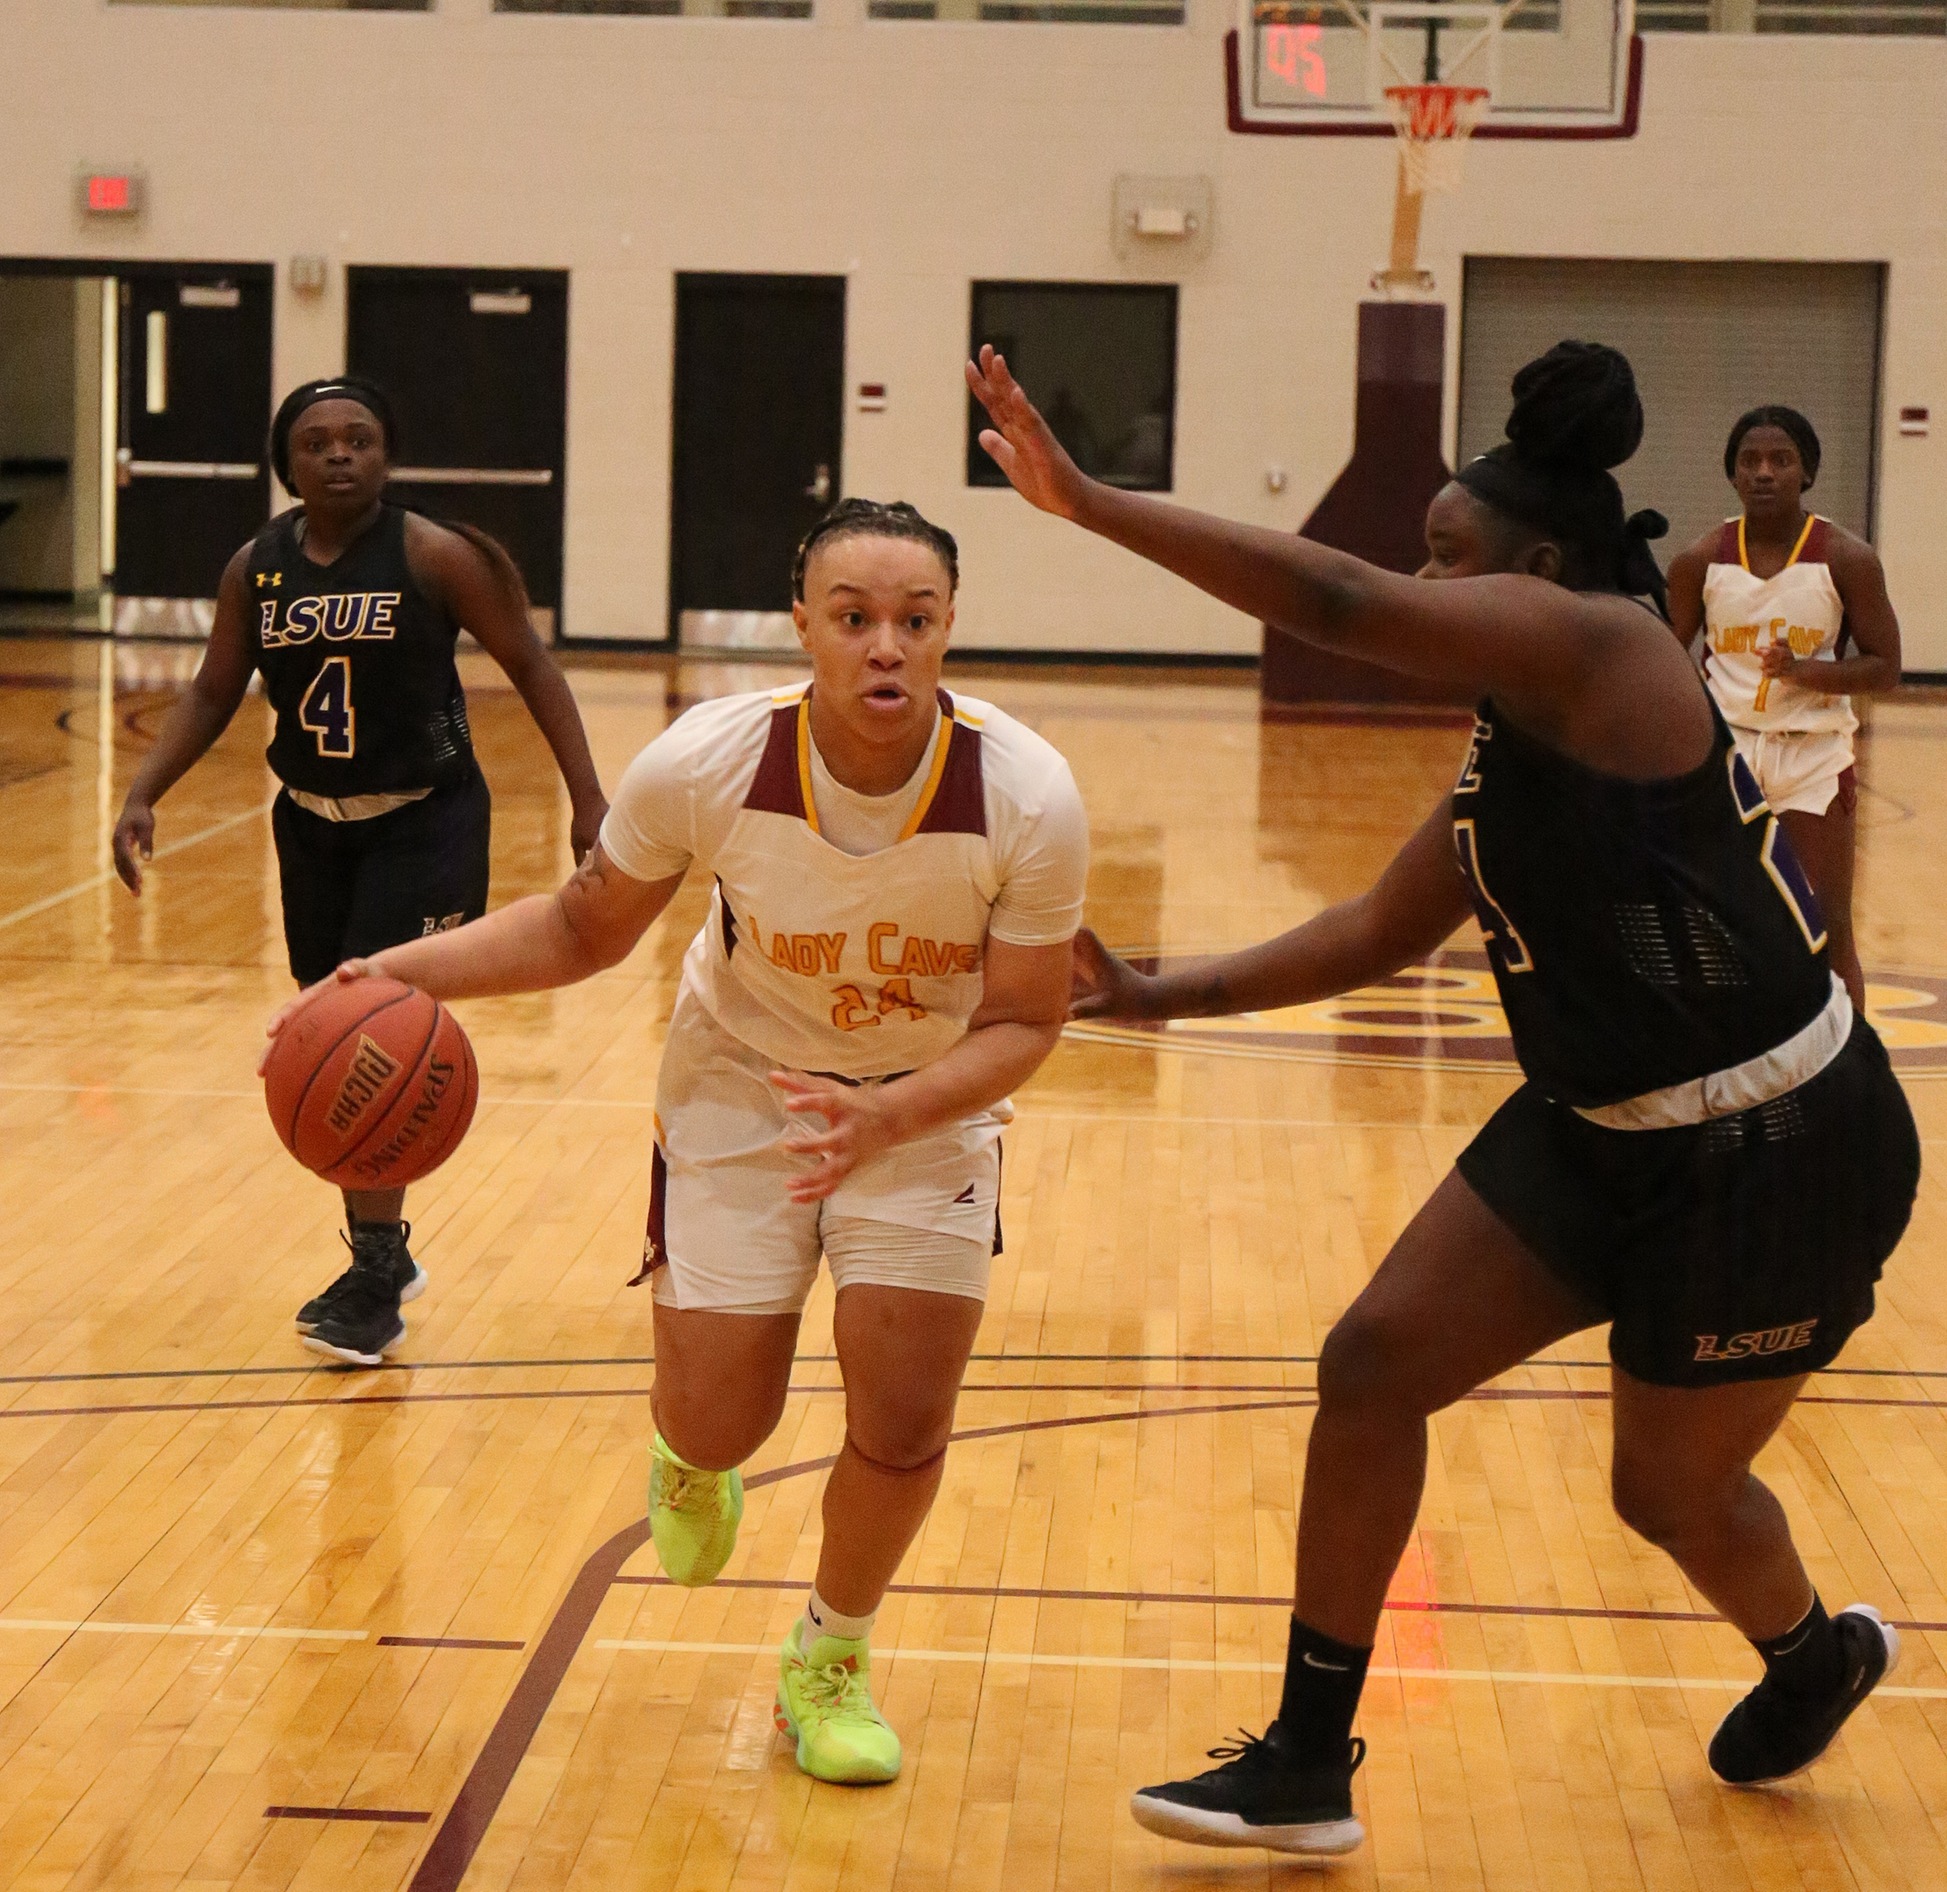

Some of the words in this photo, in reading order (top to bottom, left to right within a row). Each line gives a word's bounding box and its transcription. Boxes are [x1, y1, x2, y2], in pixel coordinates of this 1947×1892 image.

[260, 592, 402, 649] LSUE
[299, 656, 355, 760] 4
[830, 978, 928, 1032] 24
[329, 1041, 397, 1132] NJCAA
[352, 1053, 455, 1178] SPALDING
[1694, 1318, 1819, 1362] LSUE
